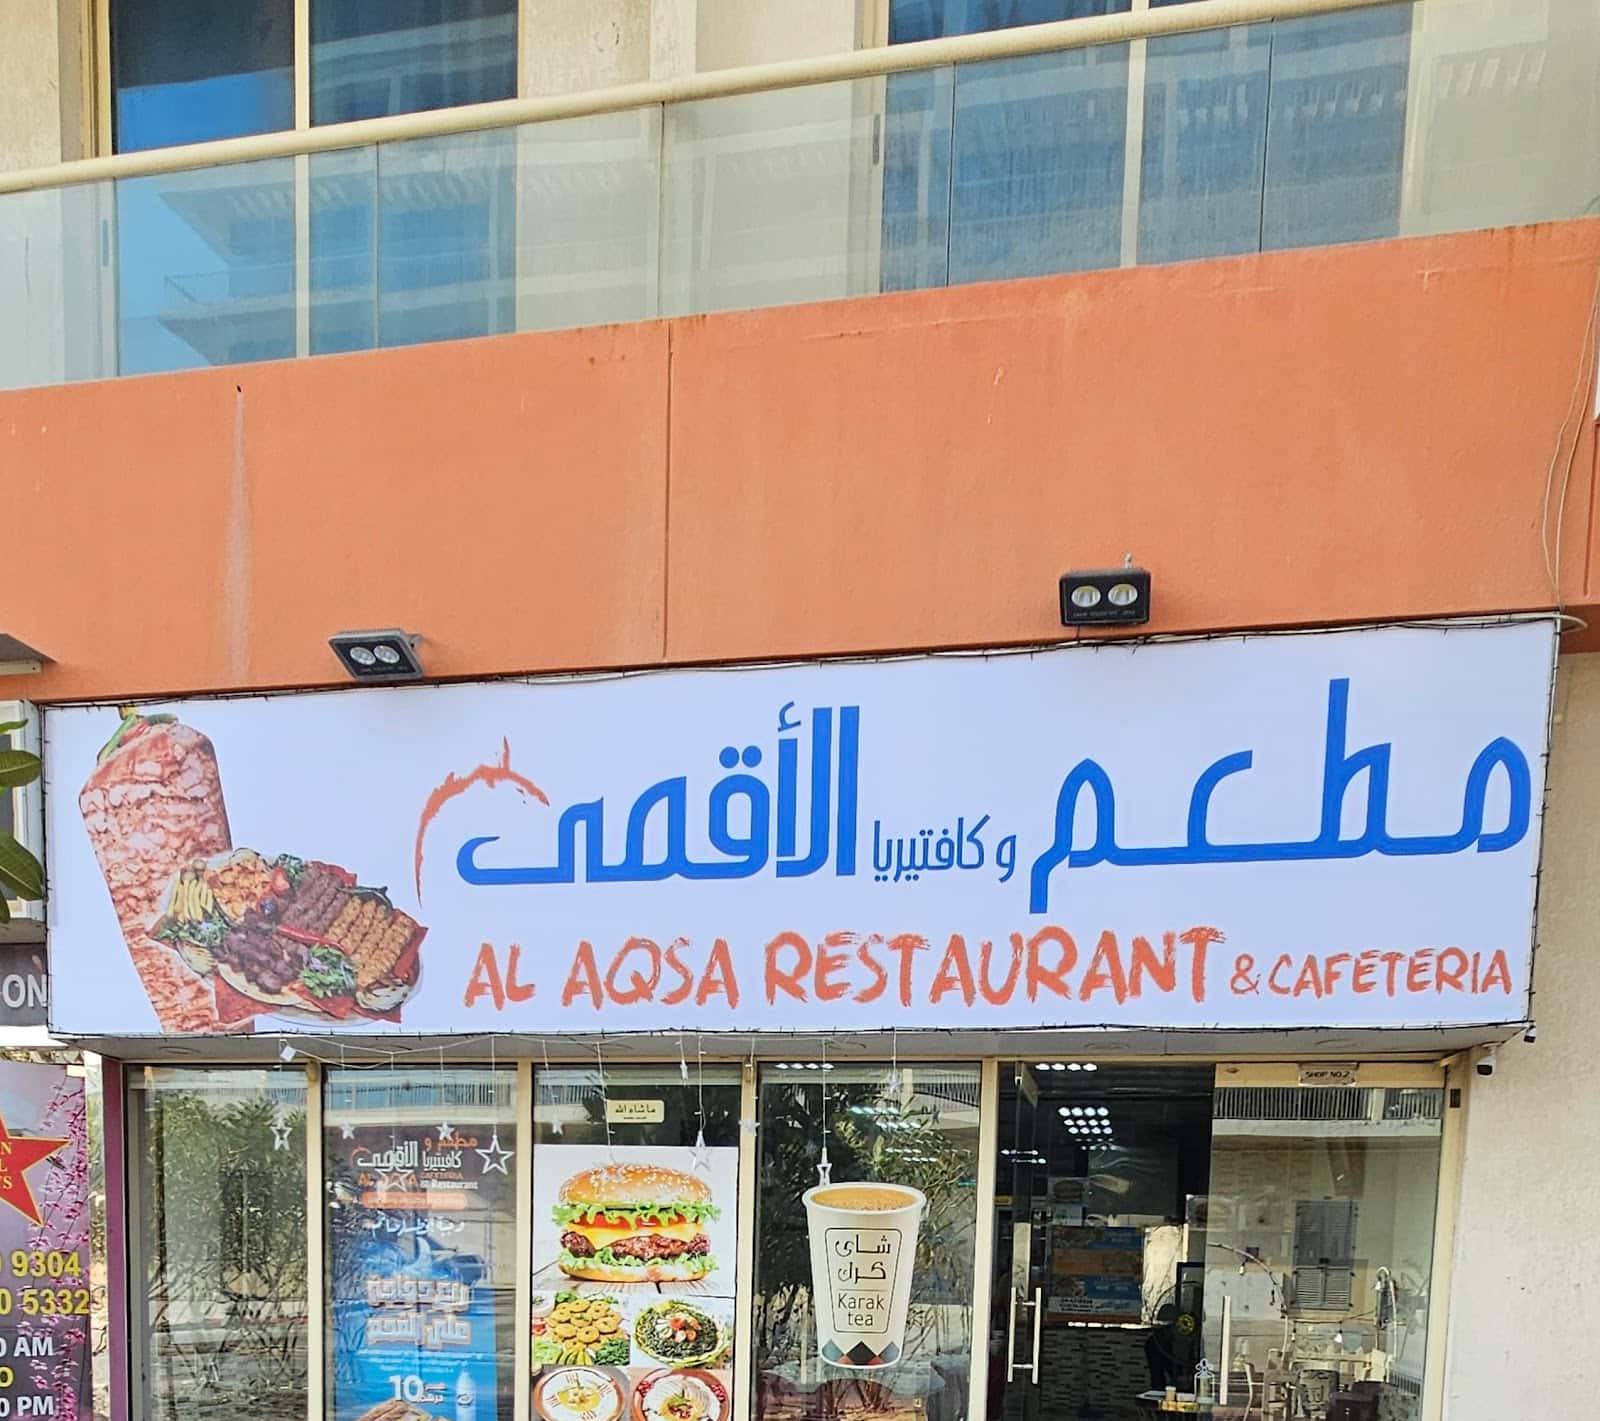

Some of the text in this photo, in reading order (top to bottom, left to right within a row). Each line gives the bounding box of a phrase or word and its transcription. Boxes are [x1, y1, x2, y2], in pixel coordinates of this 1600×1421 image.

[1029, 678, 1533, 914] مطعم
[873, 814, 990, 883] كافتيريا
[995, 834, 1017, 883] و
[465, 926, 1513, 1010] AL AQSA RESTAURANT & CAFETERIA
[0, 1176, 13, 1189] S
[11, 1250, 82, 1278] 9304
[22, 1288, 90, 1316] 5332
[837, 1292, 885, 1310] Karak
[847, 1311, 873, 1326] tea
[13, 1336, 54, 1357] AM
[389, 1375, 424, 1403] 10
[16, 1395, 55, 1418] PM
